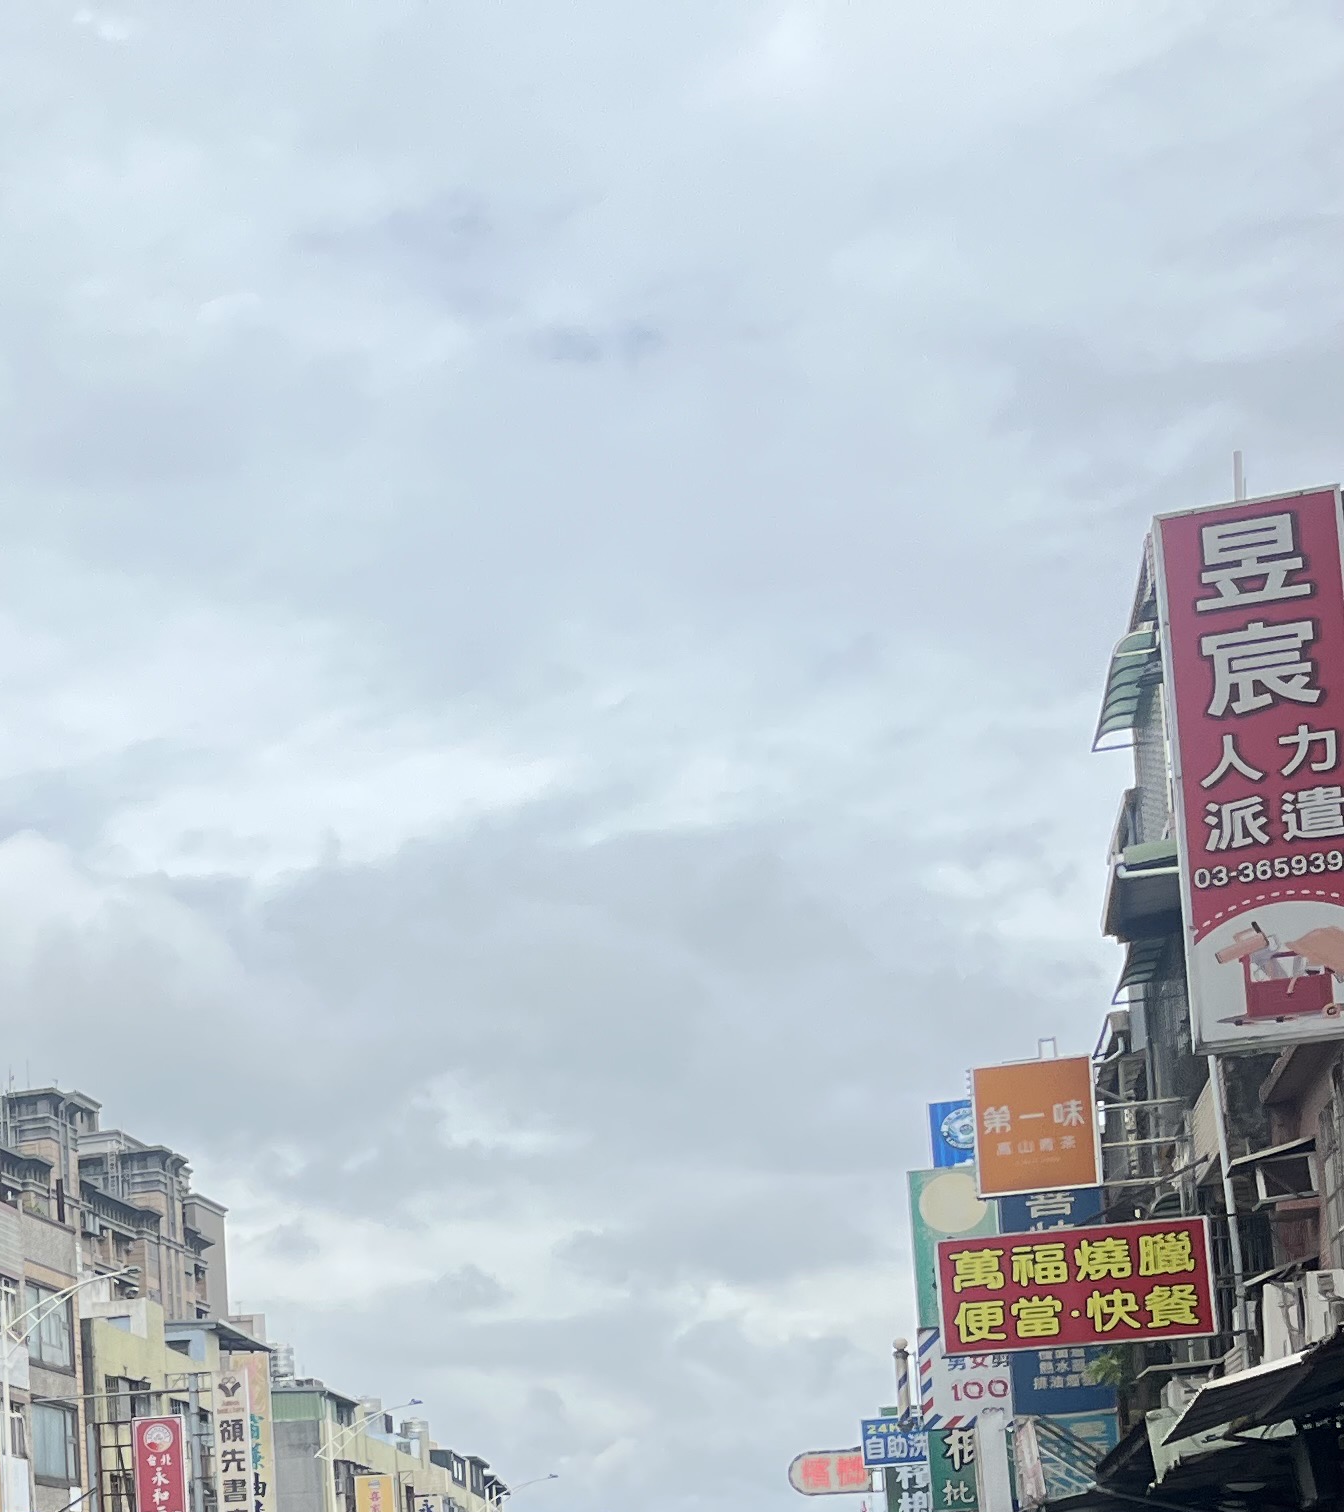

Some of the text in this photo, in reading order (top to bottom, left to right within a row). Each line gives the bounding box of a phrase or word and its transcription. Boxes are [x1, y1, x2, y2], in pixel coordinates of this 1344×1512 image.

[1195, 512, 1321, 719] 昱宸
[1201, 724, 1338, 789] 人力
[1204, 786, 1344, 851] 派遣
[983, 1099, 1085, 1134] 第一味
[948, 1230, 1195, 1292] 萬福燒臘
[951, 1379, 1008, 1401] 100
